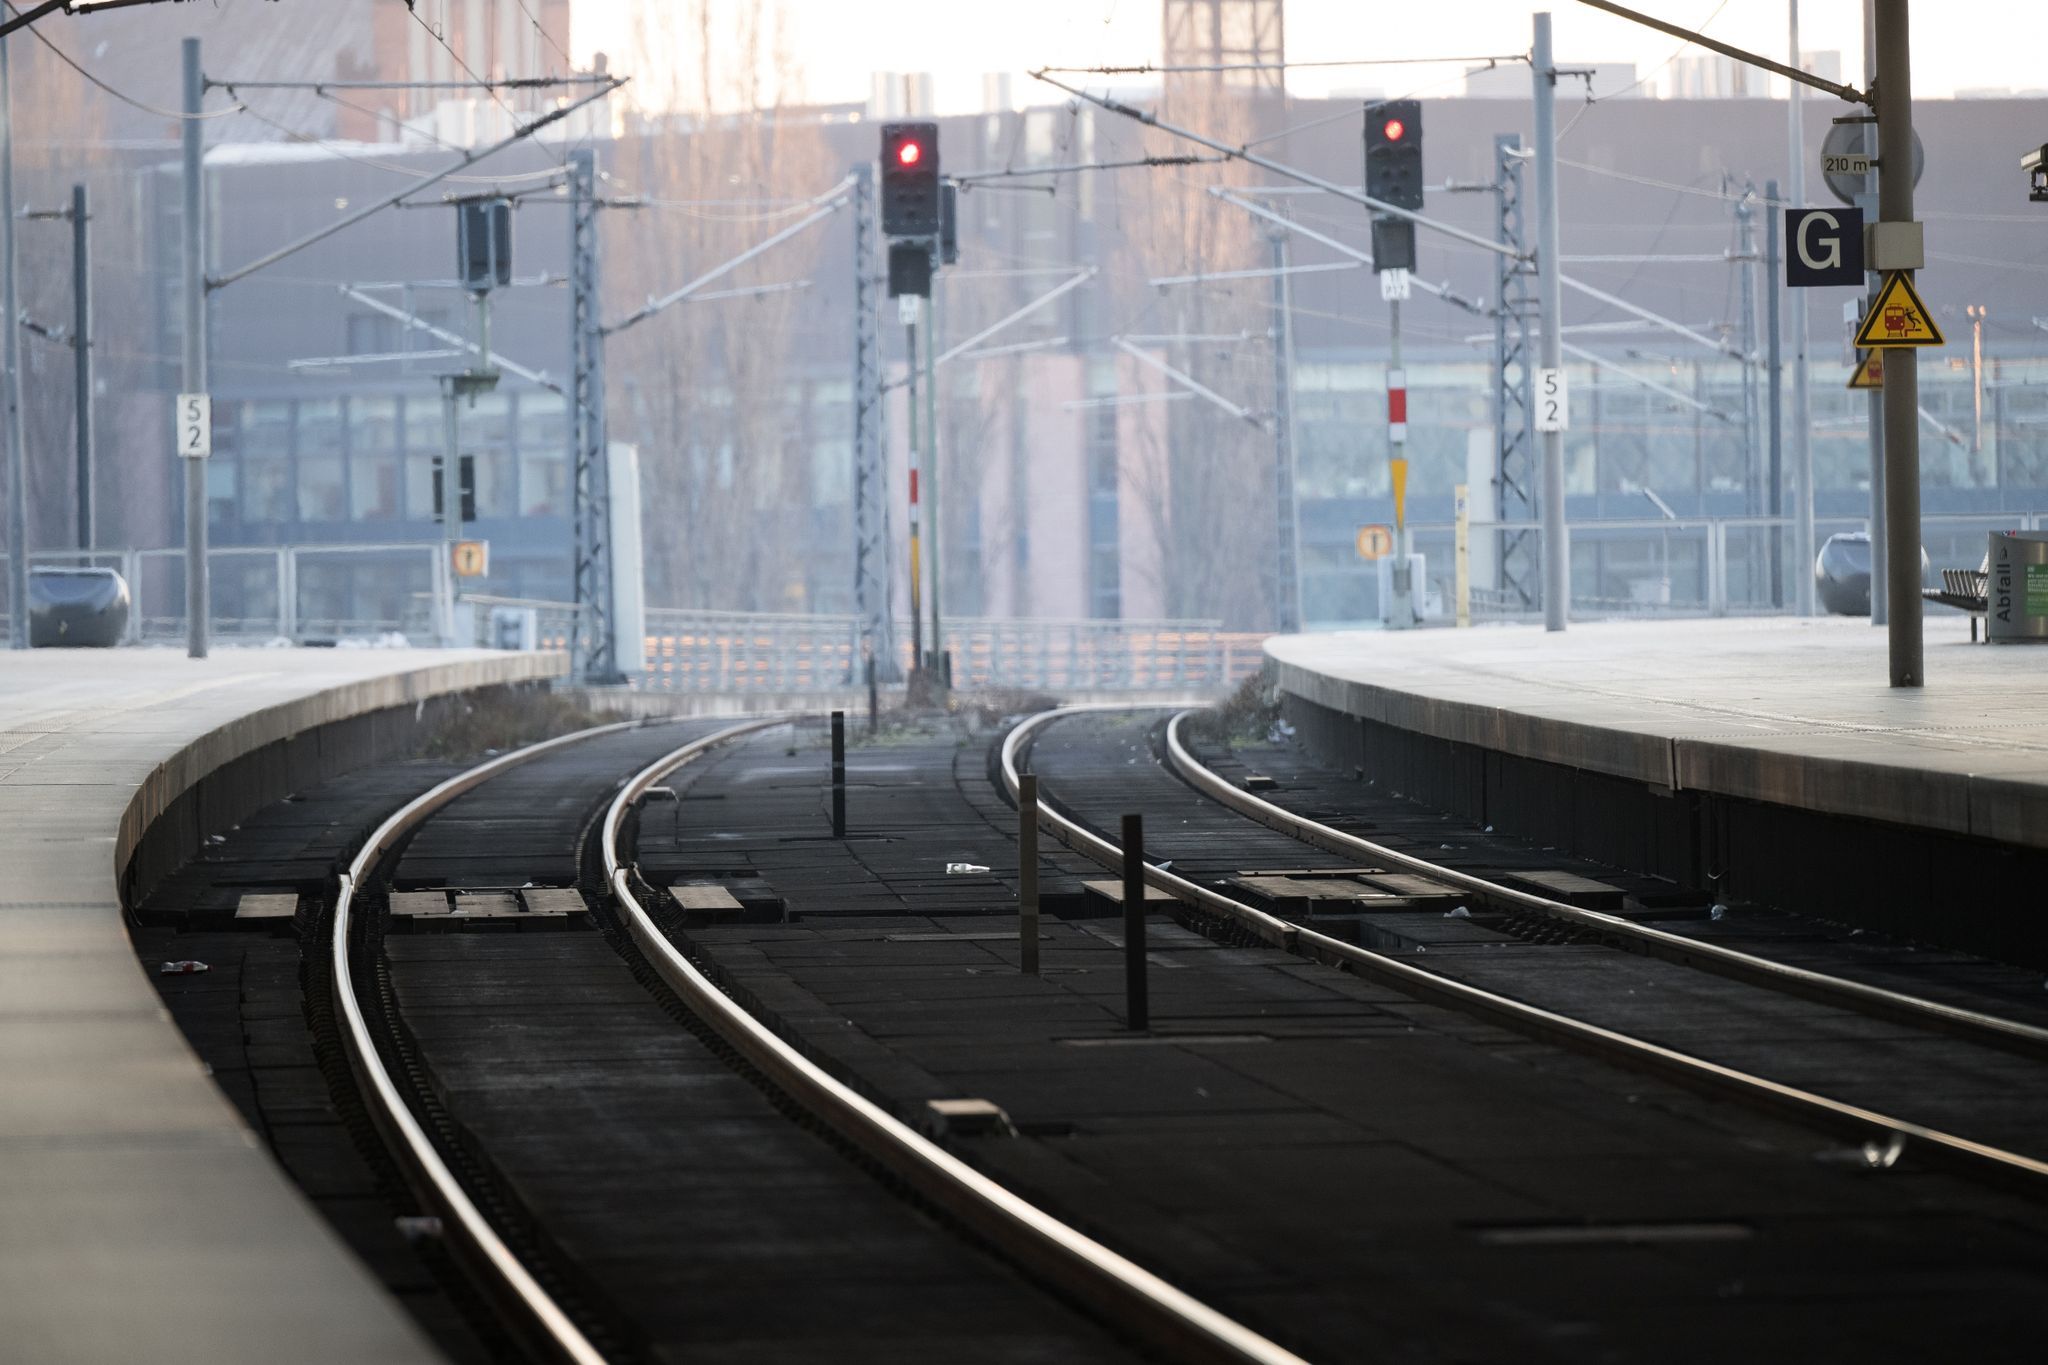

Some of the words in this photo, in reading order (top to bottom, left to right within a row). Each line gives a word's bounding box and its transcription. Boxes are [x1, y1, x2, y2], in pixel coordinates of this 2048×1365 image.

[1825, 157, 1849, 172] 210
[1853, 159, 1867, 171] m
[1797, 211, 1841, 270] G
[1545, 374, 1557, 395] 5
[188, 399, 201, 422] 5
[1545, 400, 1558, 421] 2
[188, 425, 201, 448] 2
[1996, 563, 2011, 622] Abfall
